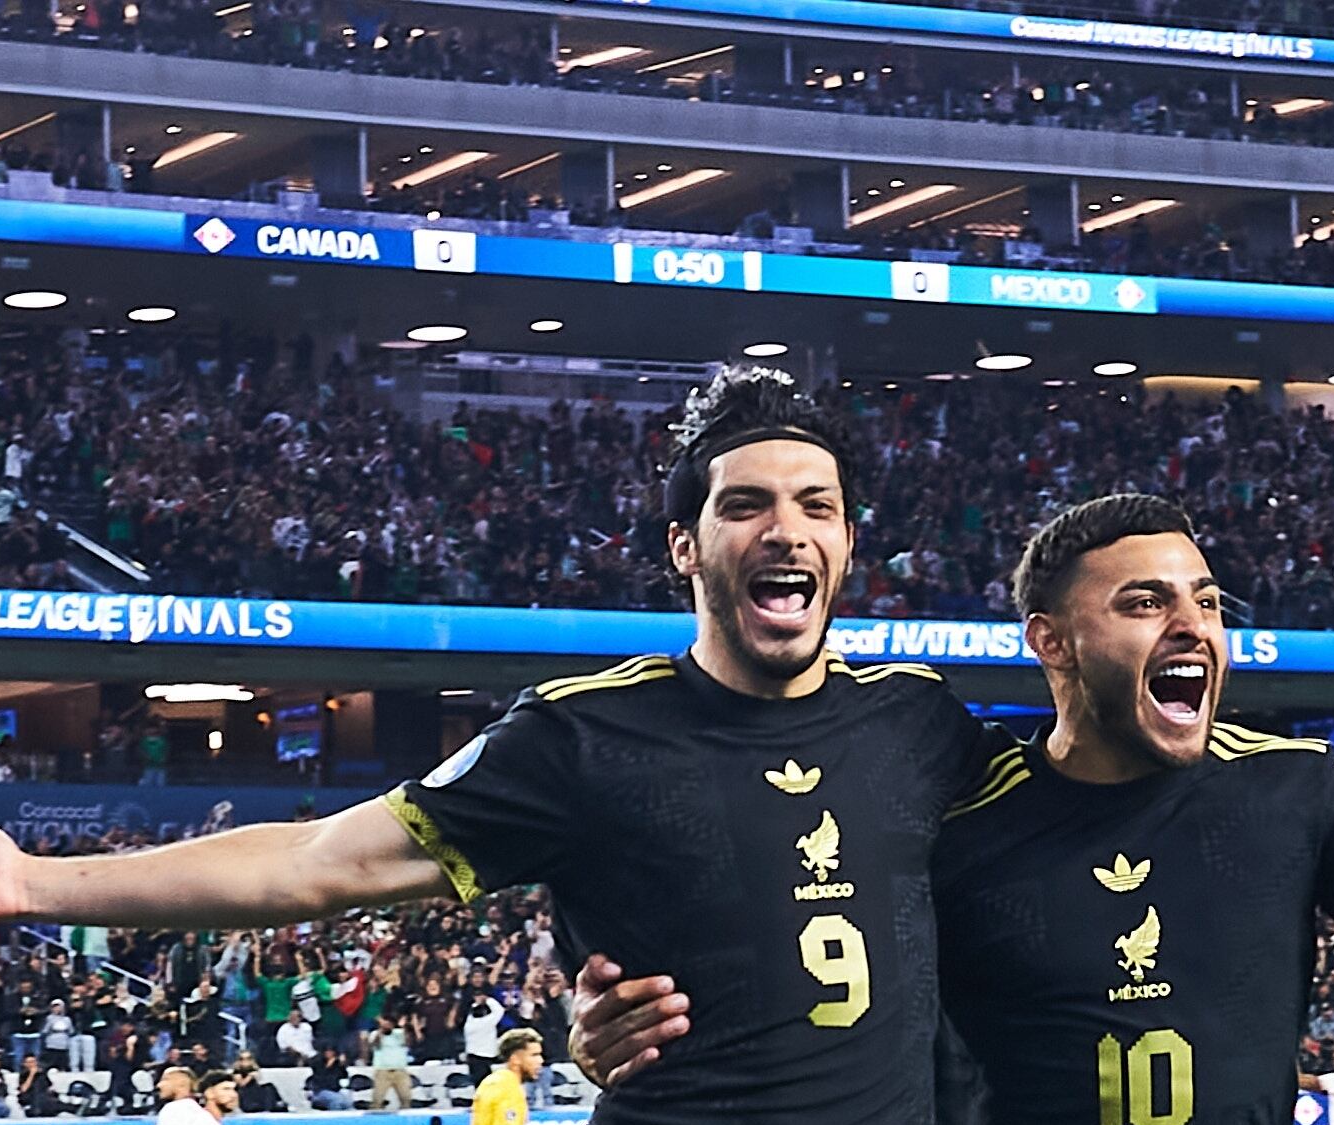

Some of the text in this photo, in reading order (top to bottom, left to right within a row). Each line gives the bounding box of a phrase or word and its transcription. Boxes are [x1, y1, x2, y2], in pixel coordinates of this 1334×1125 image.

[257, 225, 380, 261] CANADA
[653, 250, 724, 284] 0:50
[990, 274, 1091, 305] MEXICO
[890, 622, 1021, 658] NATIONS
[794, 882, 854, 901] MÉXICO
[799, 914, 870, 1027] 9
